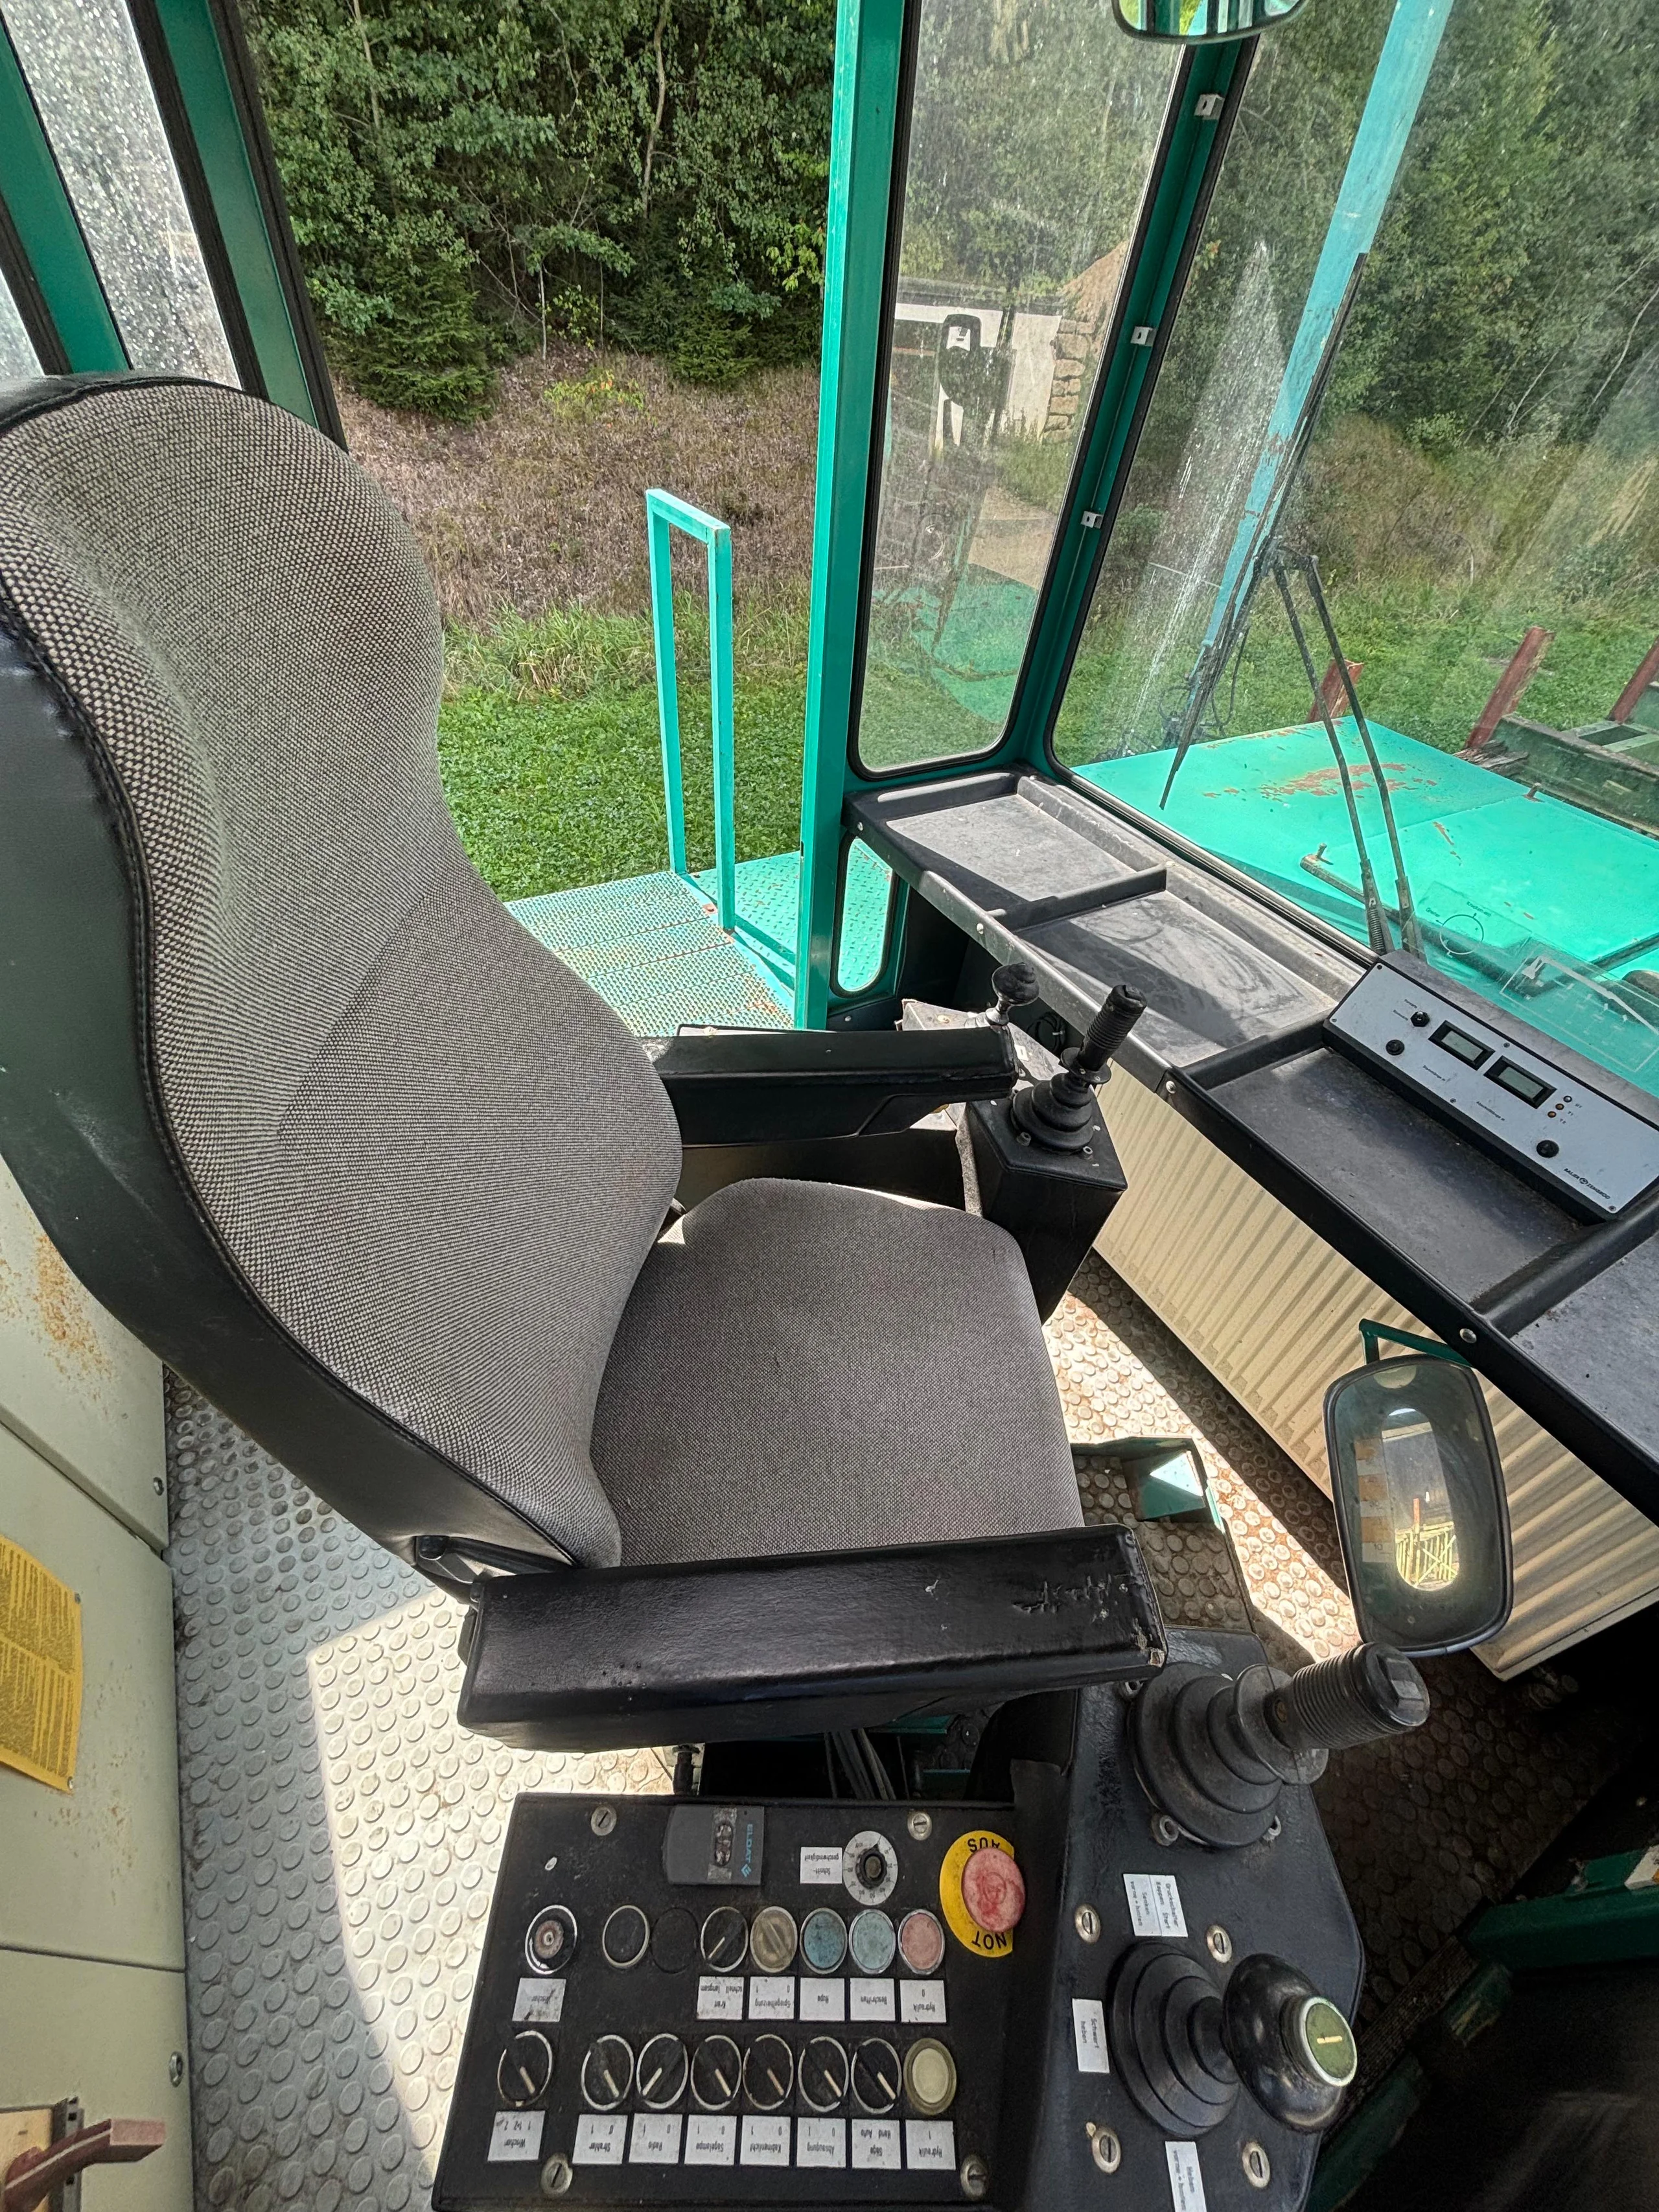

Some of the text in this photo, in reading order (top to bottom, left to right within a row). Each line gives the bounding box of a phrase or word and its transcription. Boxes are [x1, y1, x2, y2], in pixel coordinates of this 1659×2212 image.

[968, 1837, 1000, 1852] AUS
[971, 1931, 1006, 1950] NOT
[919, 2147, 943, 2157] Hydraulik
